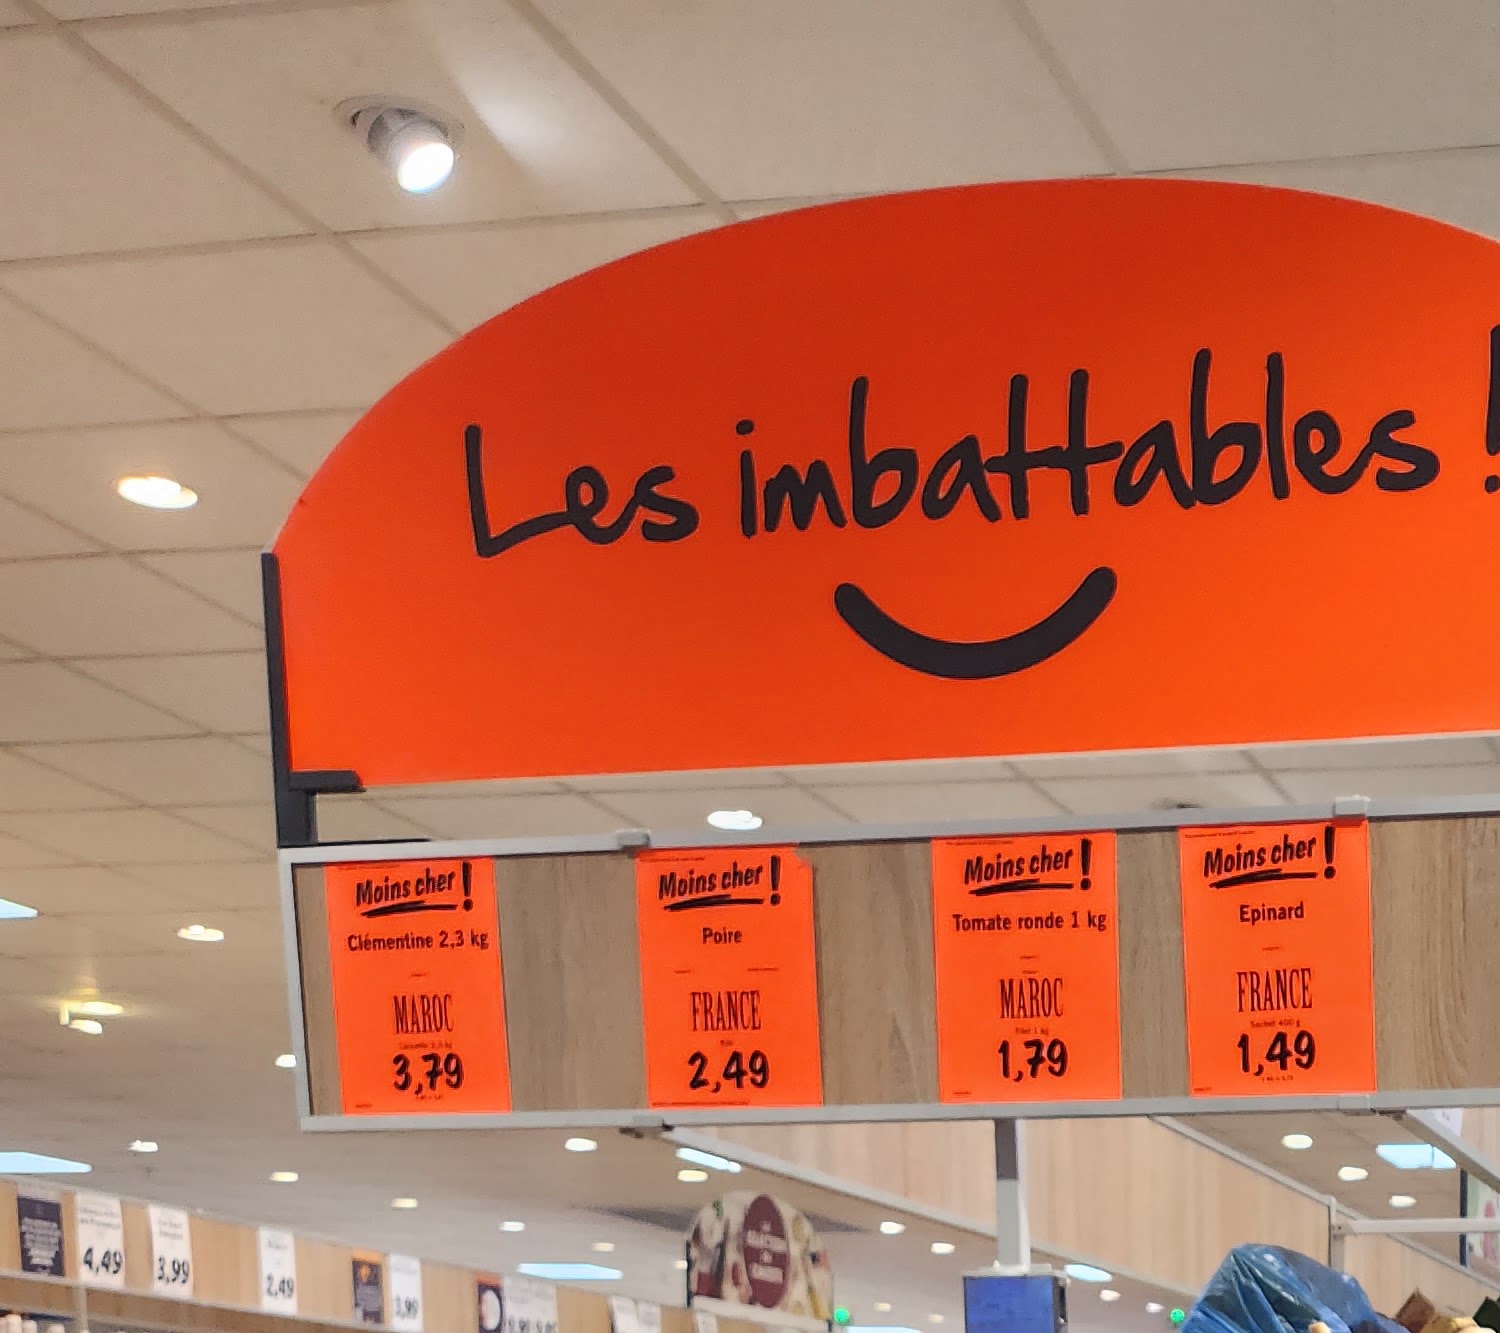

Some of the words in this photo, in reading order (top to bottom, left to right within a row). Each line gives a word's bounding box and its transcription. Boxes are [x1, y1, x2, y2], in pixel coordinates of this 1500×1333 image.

[465, 424, 699, 556] Les
[737, 348, 1440, 537] imbattables
[964, 854, 1025, 885] Moins
[1028, 844, 1074, 874] cher
[1080, 838, 1092, 890] !
[1203, 843, 1266, 878] Moins
[1270, 834, 1316, 864] cher
[1324, 826, 1336, 879] !
[355, 876, 411, 907] Moins
[415, 868, 456, 896] cher
[462, 861, 473, 911] !
[658, 869, 717, 900] Moins
[721, 861, 763, 889] cher
[770, 855, 781, 906] !
[952, 913, 1012, 932] Tomate
[1017, 911, 1064, 930] ronde
[1071, 911, 1079, 928] 1
[1087, 910, 1107, 932] kg
[1239, 901, 1304, 926] Epinard
[347, 933, 434, 951] Clémentine
[439, 930, 465, 949] 2,3
[470, 929, 489, 950] kg
[702, 927, 742, 944] Poire
[691, 990, 761, 1031] FRANCE
[1000, 977, 1063, 1019] MAROC
[1236, 968, 1313, 1013] FRANCE
[393, 994, 454, 1034] MAROC
[393, 1052, 464, 1096] 3,79
[687, 1050, 769, 1093] 2,49
[997, 1038, 1069, 1082] 1,79
[1237, 1030, 1316, 1076] 1,49
[83, 1246, 123, 1277] 4,49
[157, 1256, 190, 1286] 3,99
